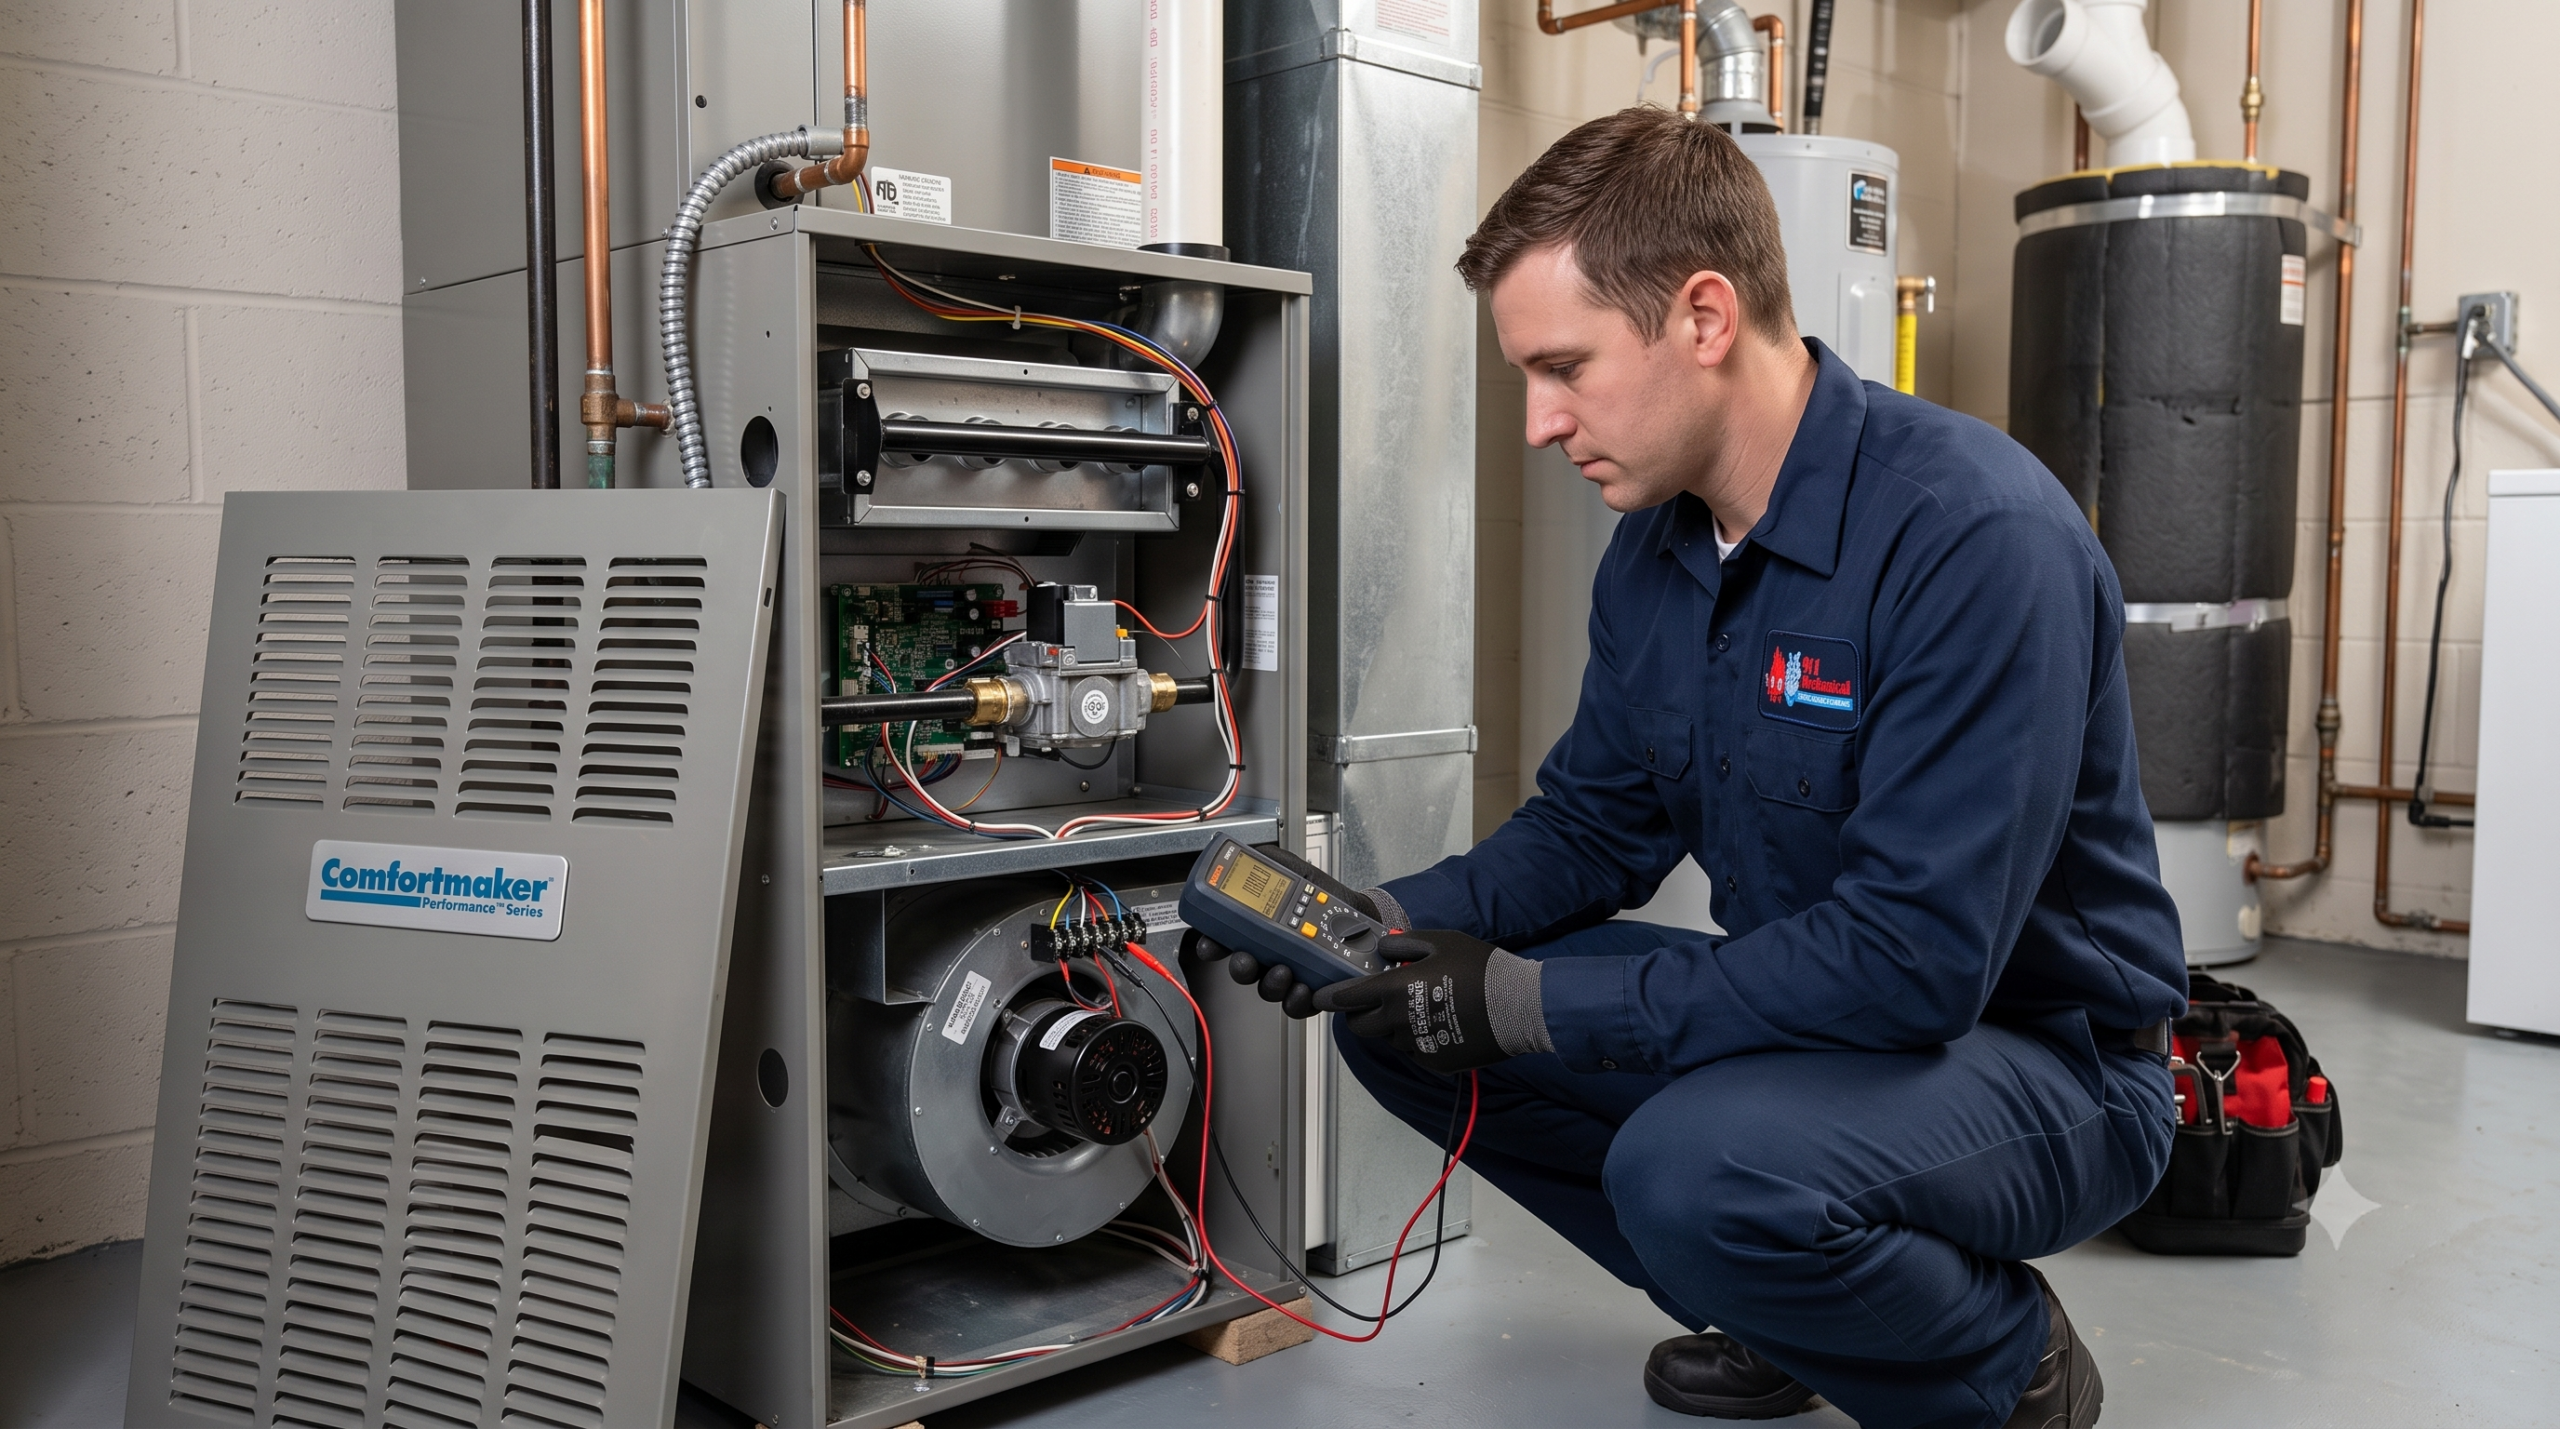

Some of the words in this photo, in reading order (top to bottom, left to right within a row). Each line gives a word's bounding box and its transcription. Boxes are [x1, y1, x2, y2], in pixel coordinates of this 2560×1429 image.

[1802, 656, 1820, 676] 911
[321, 858, 548, 902] Comfortmaker
[506, 904, 543, 917] Series
